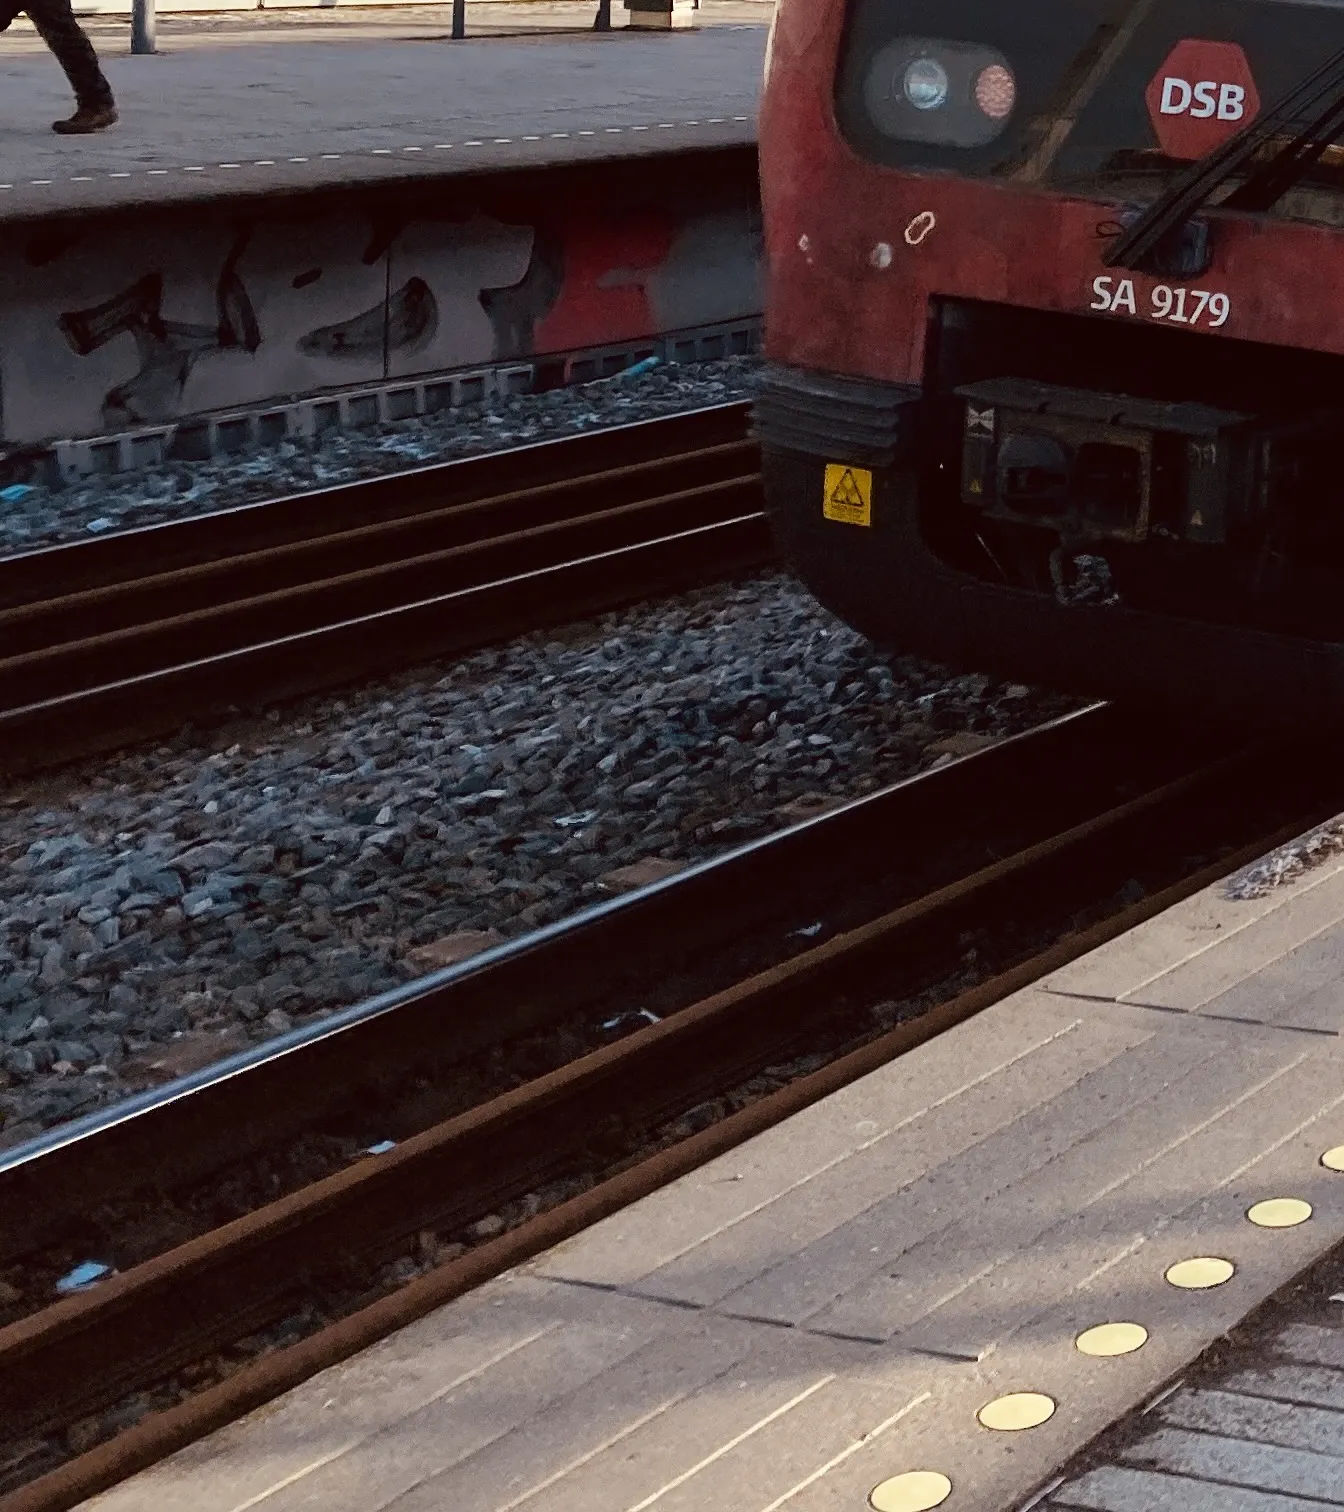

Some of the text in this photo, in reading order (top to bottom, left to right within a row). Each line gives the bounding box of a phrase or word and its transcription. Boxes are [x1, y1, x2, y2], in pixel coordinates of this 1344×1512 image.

[1159, 77, 1246, 121] DSB
[1090, 275, 1231, 327] SA 9179
